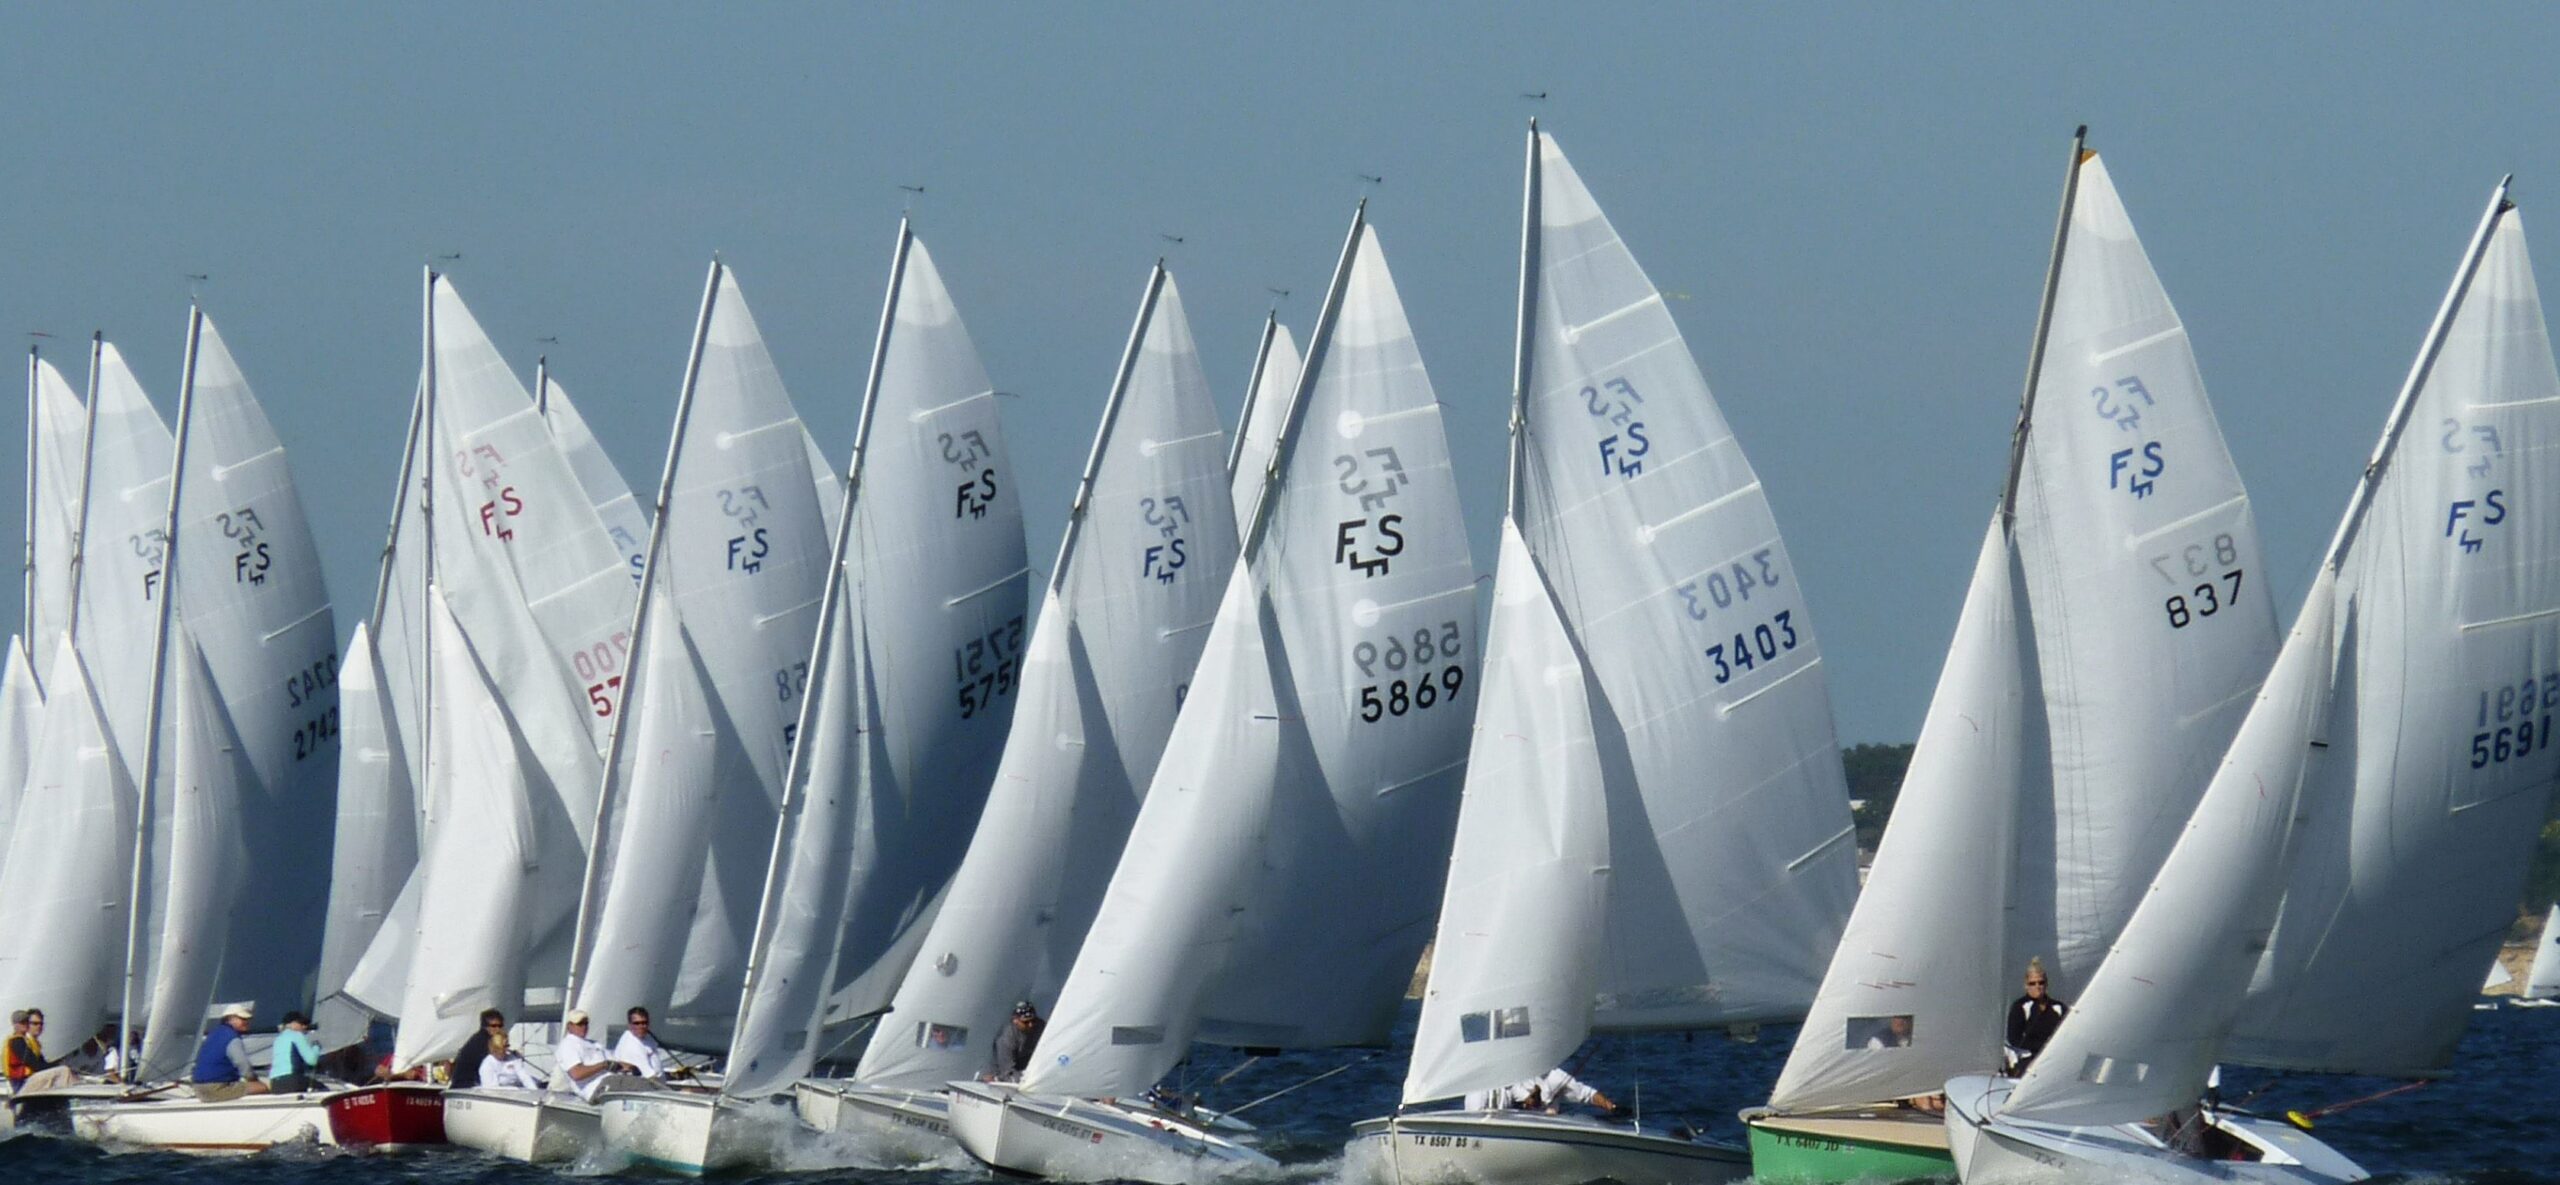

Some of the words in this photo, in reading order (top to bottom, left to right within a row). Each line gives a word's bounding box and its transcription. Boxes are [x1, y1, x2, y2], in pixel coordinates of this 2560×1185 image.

[2165, 570, 2243, 628] 837
[1705, 610, 1797, 684] 3403
[959, 653, 1021, 719] 5751
[1361, 665, 1463, 723] 5869
[294, 706, 337, 761] 2742
[2470, 715, 2551, 769] 5691
[1414, 1135, 1425, 1145] TX
[1776, 1133, 1790, 1147] TX
